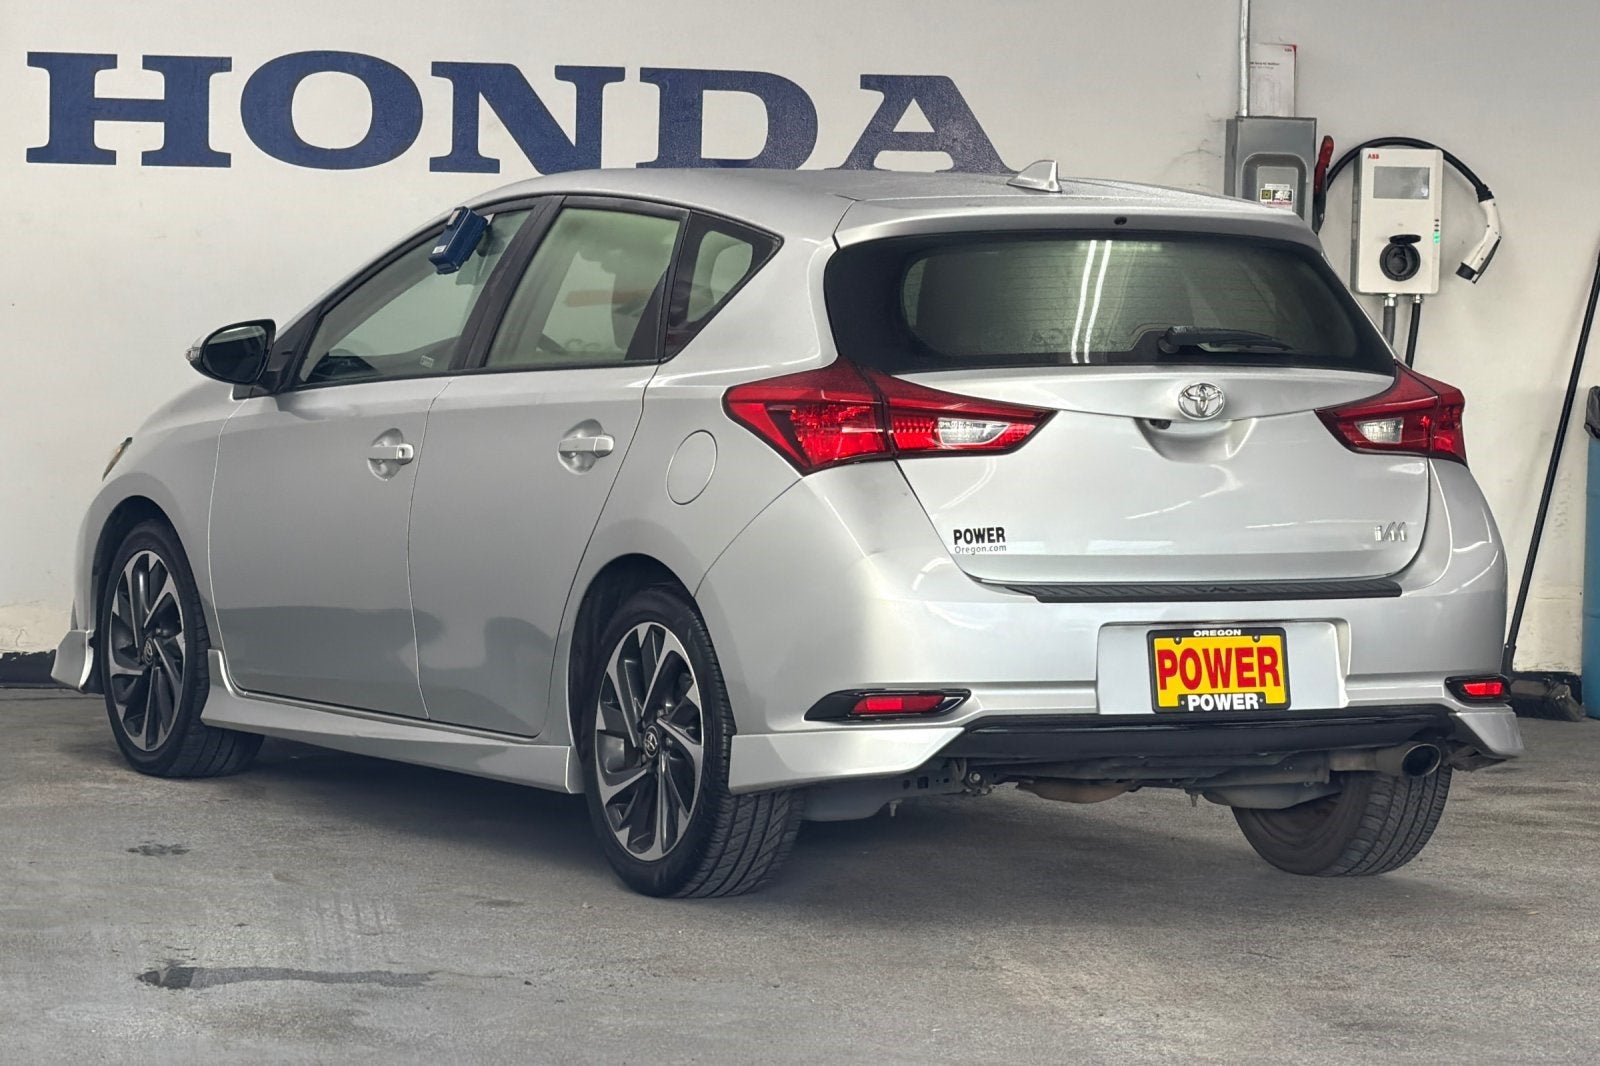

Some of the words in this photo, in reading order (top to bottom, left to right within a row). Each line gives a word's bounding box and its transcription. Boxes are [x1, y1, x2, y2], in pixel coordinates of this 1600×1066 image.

[26, 51, 1015, 173] HONDA
[953, 526, 1006, 545] POWER
[954, 544, 1007, 555] Oregon.com
[1193, 629, 1241, 637] OREGON
[1157, 646, 1281, 690] POWER
[1187, 693, 1259, 711] POWER
